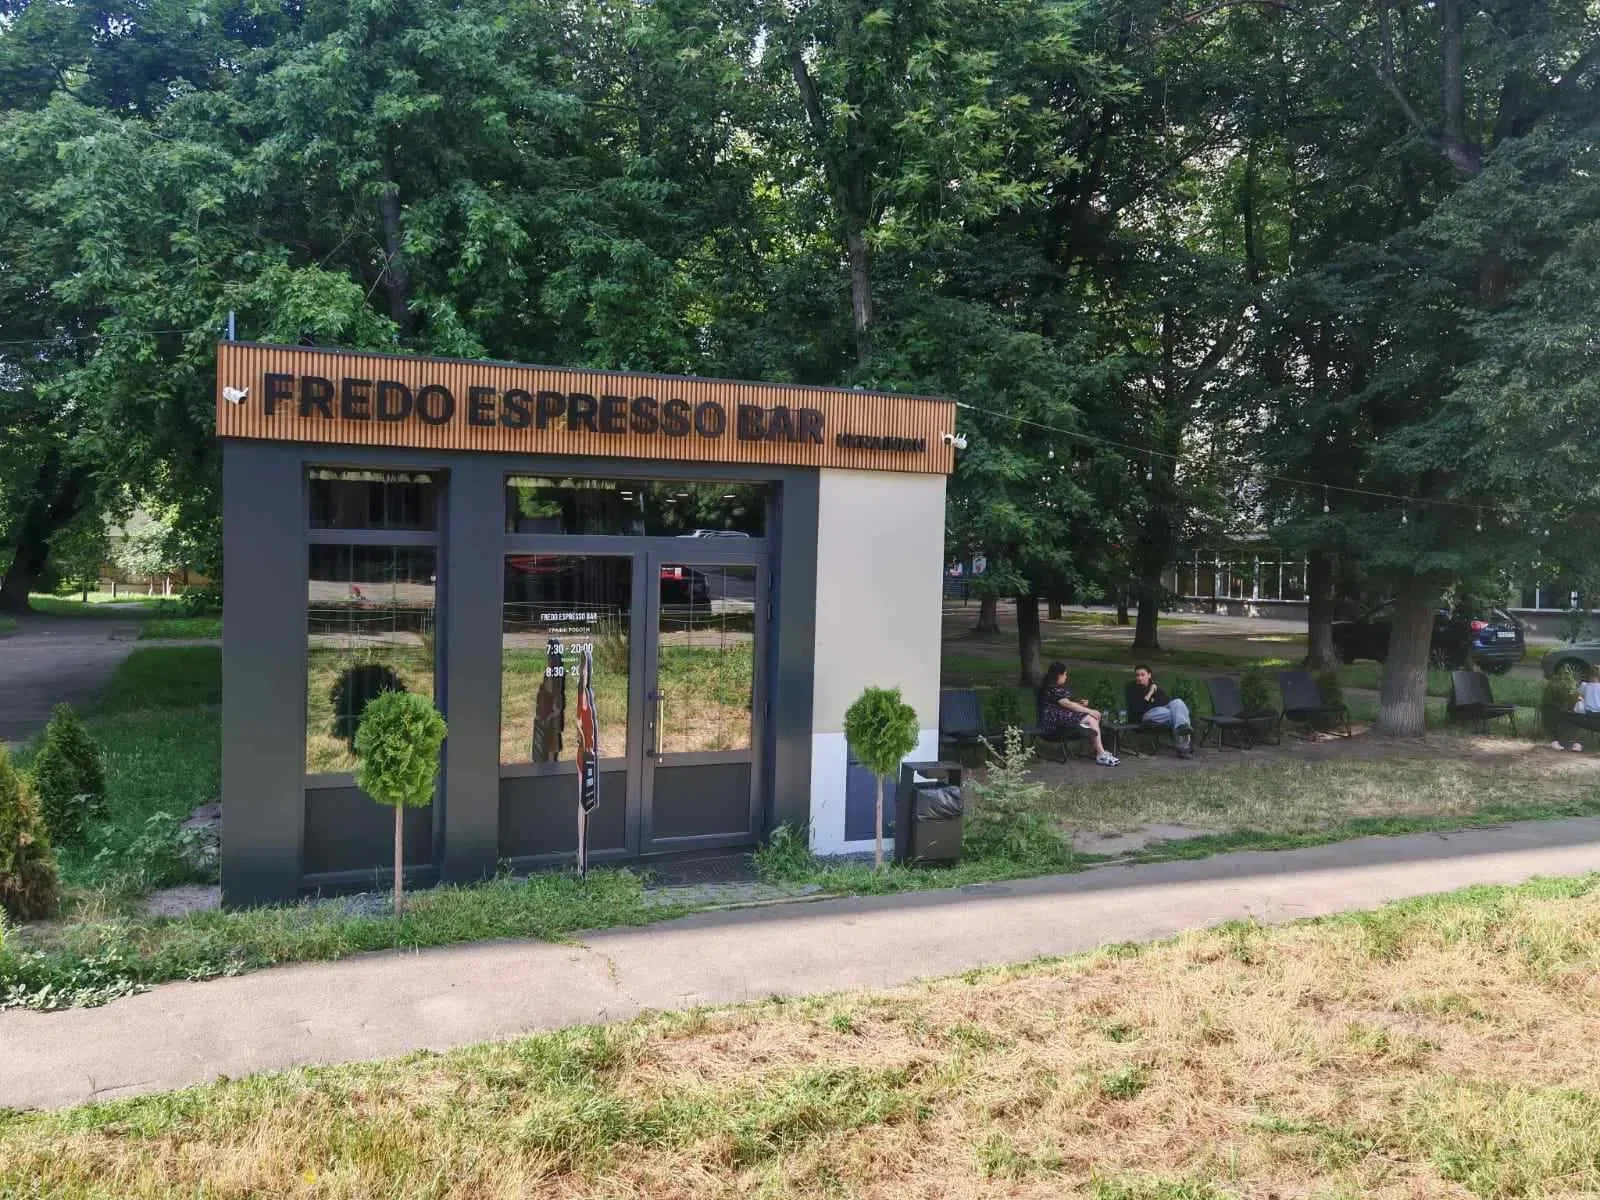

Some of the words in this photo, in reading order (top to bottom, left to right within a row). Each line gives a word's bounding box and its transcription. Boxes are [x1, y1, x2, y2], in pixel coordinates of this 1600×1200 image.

[263, 372, 456, 426] FREDO
[468, 386, 726, 439] ESPRESSO
[738, 404, 825, 444] BAR
[540, 613, 558, 621] FREDO
[586, 612, 597, 620] BAR
[546, 644, 564, 655] 7:30
[545, 667, 564, 678] 8:30
